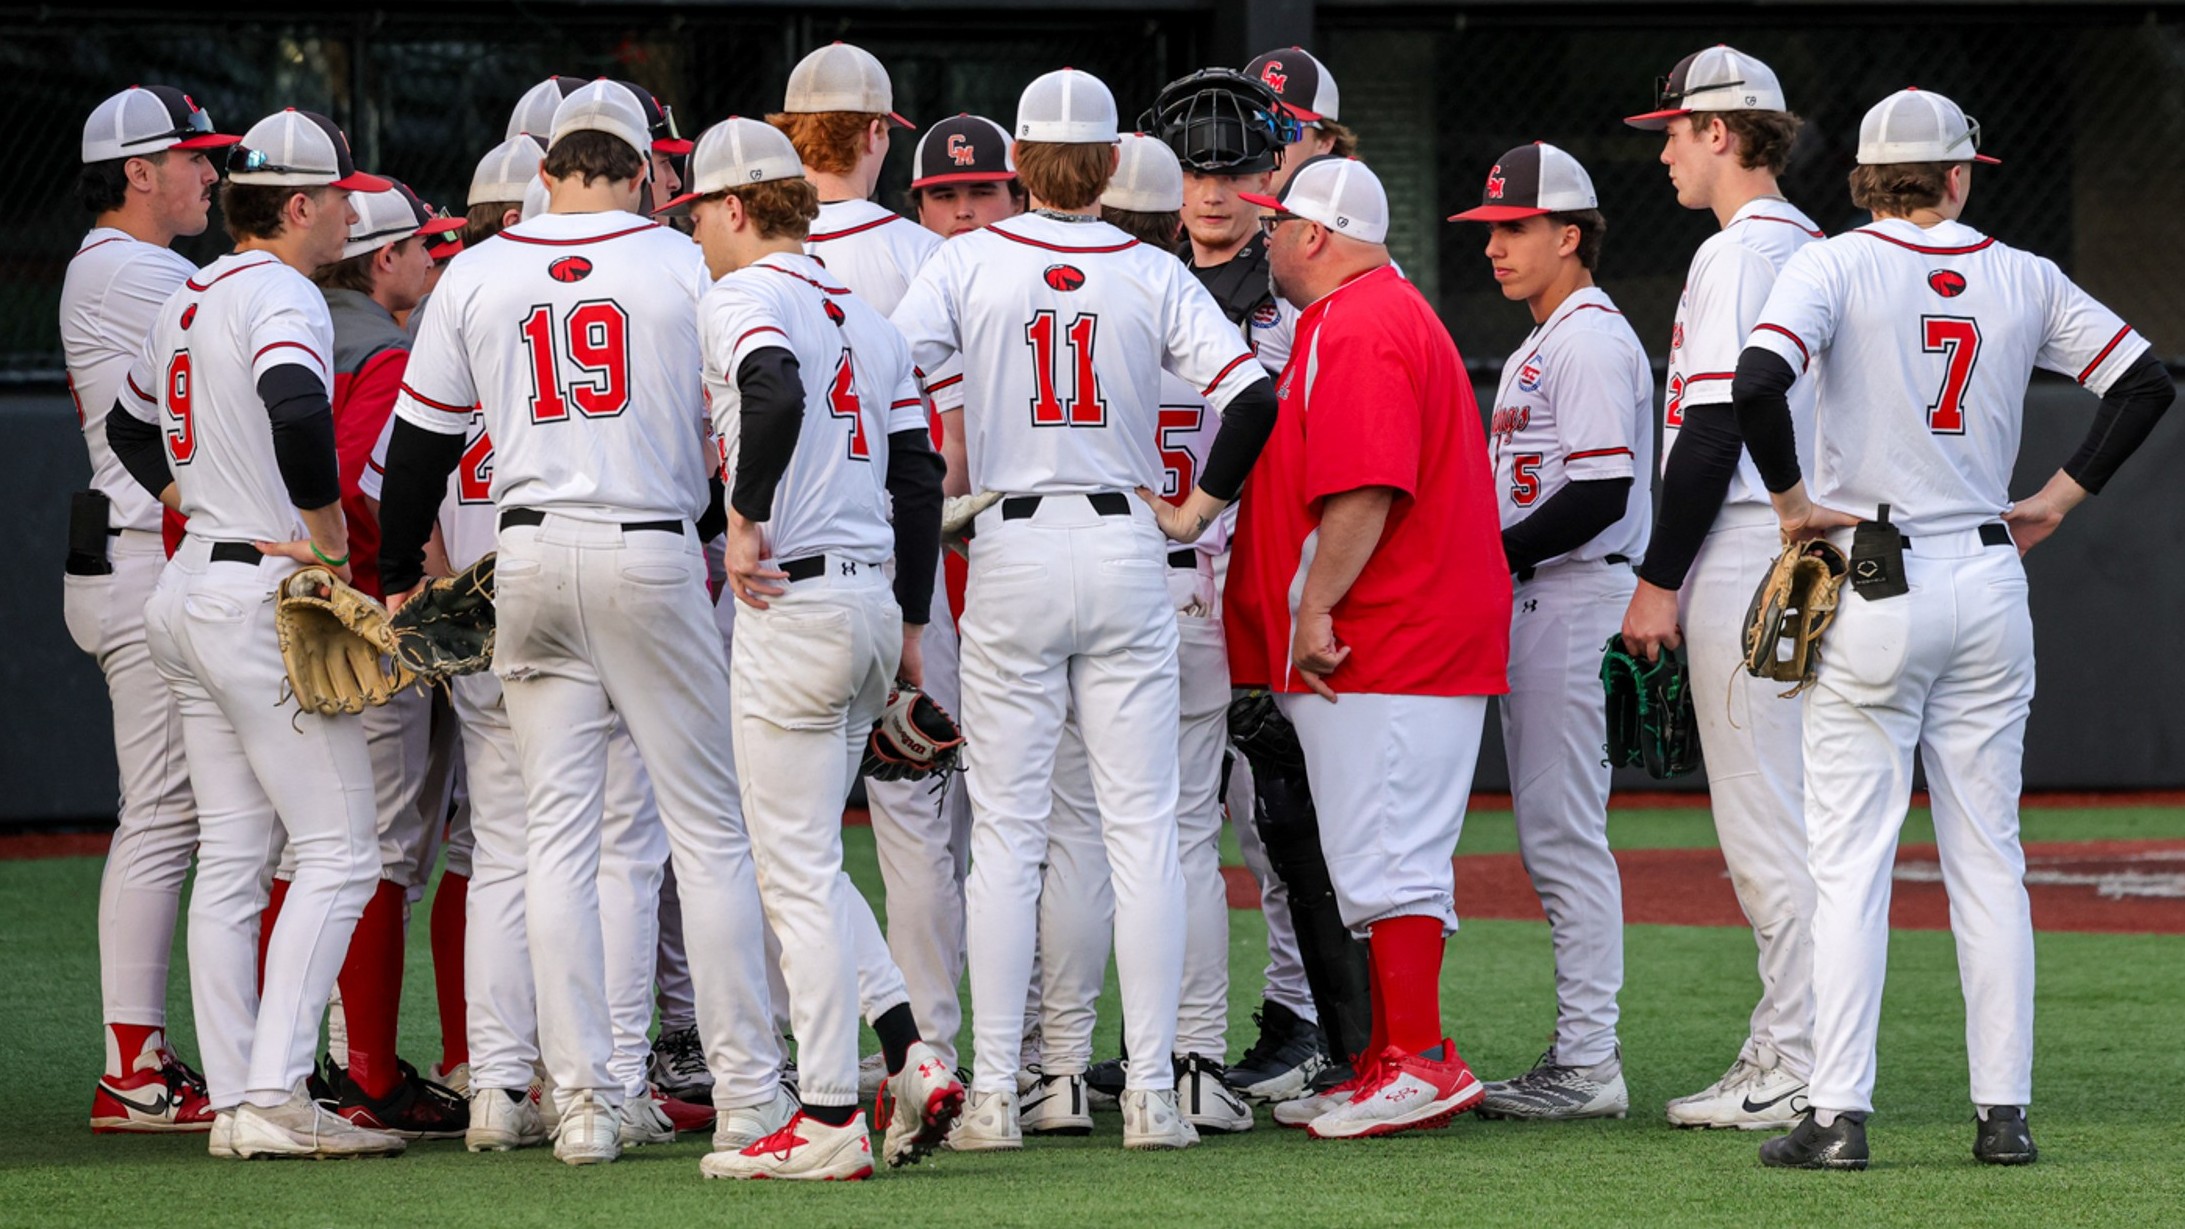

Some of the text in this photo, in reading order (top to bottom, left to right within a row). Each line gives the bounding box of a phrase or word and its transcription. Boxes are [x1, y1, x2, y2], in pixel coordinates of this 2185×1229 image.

[947, 133, 975, 166] CM
[166, 347, 197, 466] 9
[519, 298, 631, 425] 19
[826, 347, 870, 462] 4
[1025, 309, 1107, 427] 11
[1920, 314, 1982, 435] 7
[1510, 452, 1543, 508] 5
